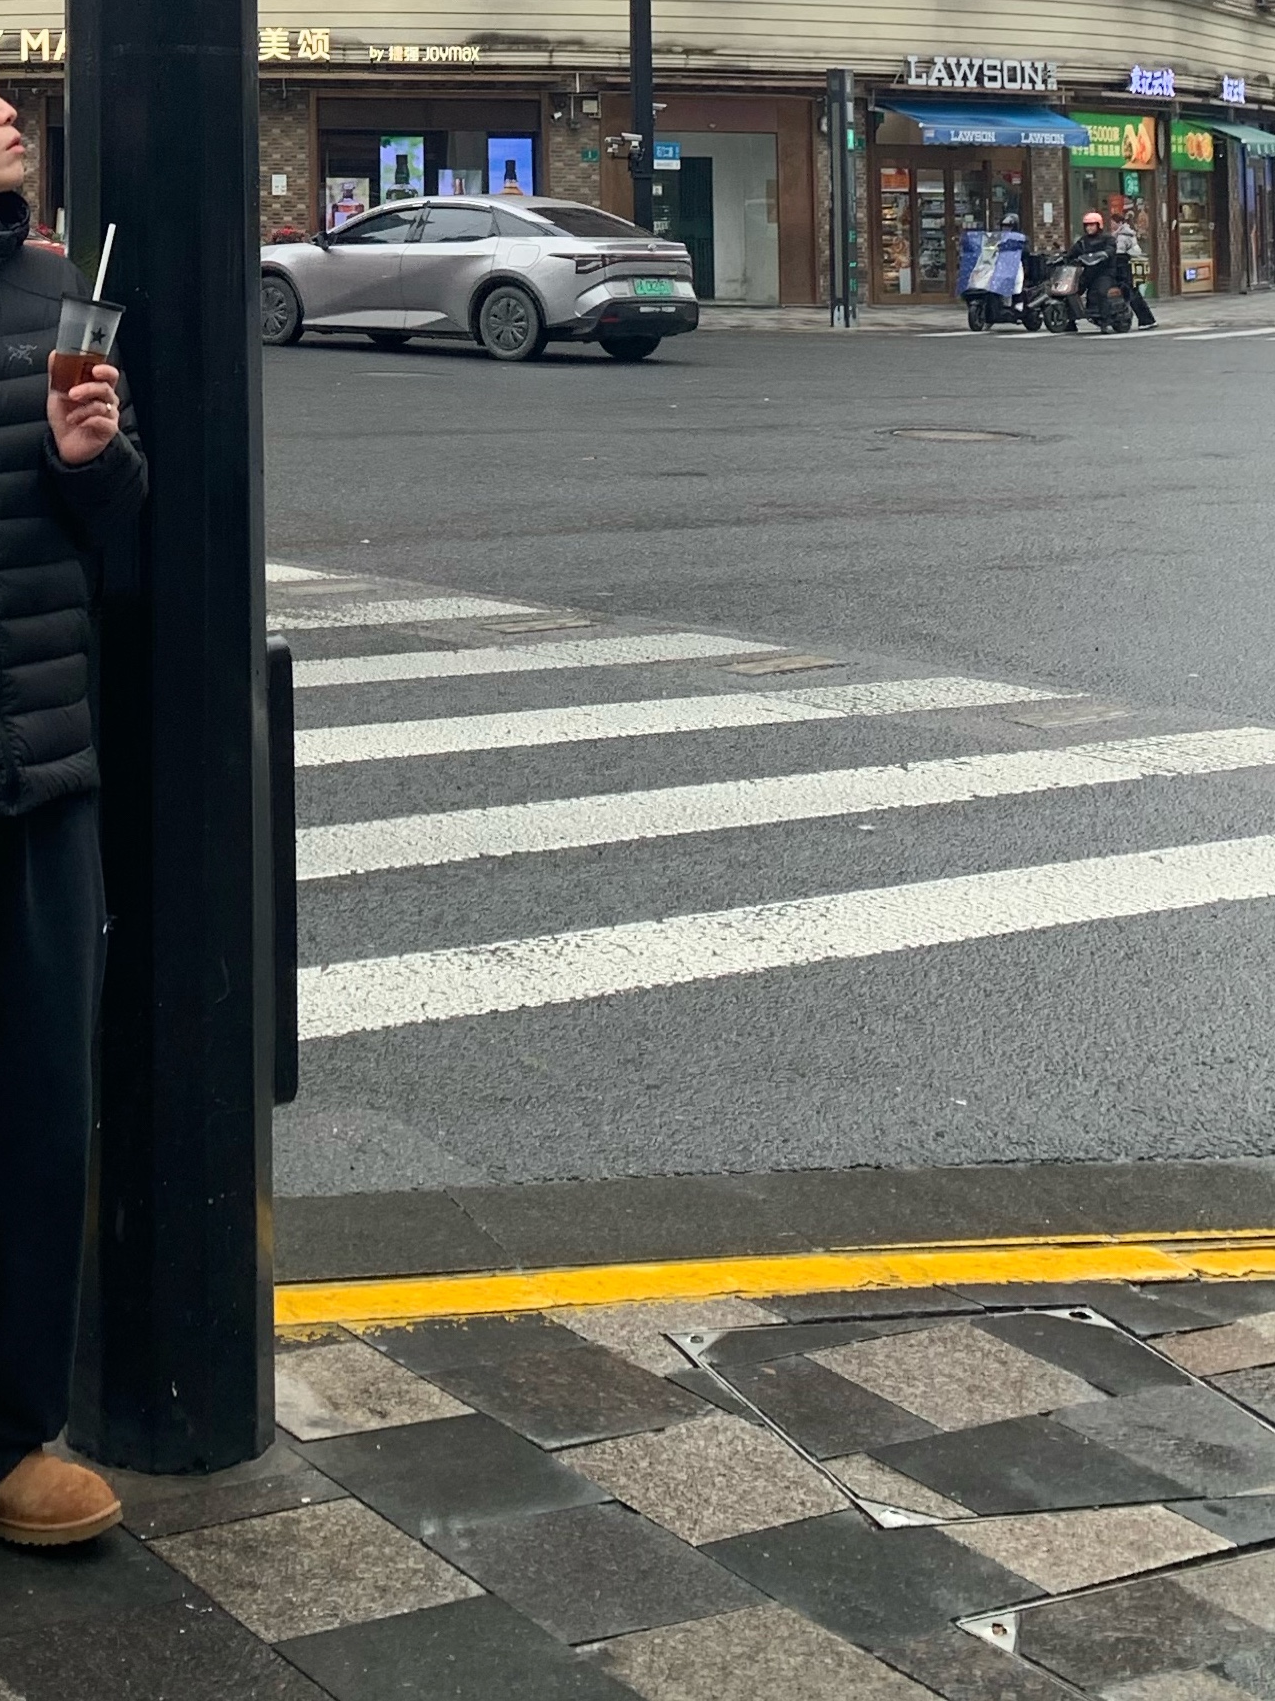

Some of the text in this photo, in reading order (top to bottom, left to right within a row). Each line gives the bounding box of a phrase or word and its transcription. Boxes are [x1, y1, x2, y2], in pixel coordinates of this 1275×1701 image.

[369, 45, 384, 61] by
[907, 55, 1046, 91] LAWSON
[950, 130, 996, 142] LAWSON
[1021, 132, 1065, 145] LAWSON
